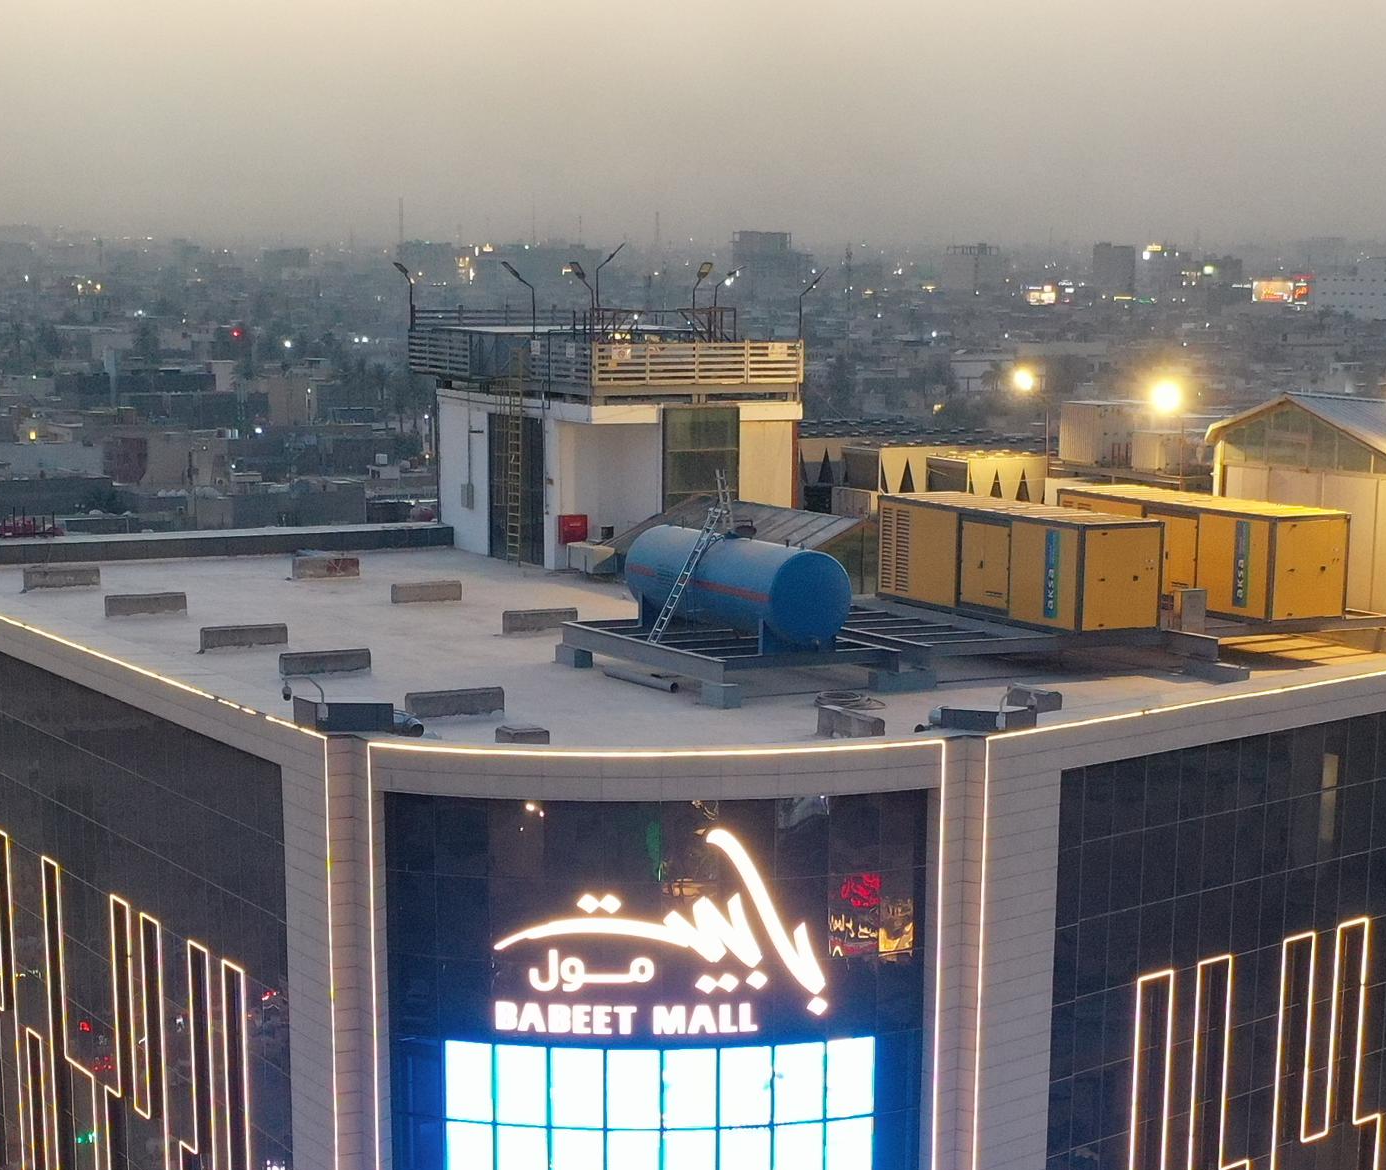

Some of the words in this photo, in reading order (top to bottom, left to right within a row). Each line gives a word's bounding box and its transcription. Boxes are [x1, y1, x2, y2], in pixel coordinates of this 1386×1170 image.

[528, 949, 655, 993] مول
[494, 1001, 638, 1036] BABEET
[653, 1002, 759, 1036] MALL
